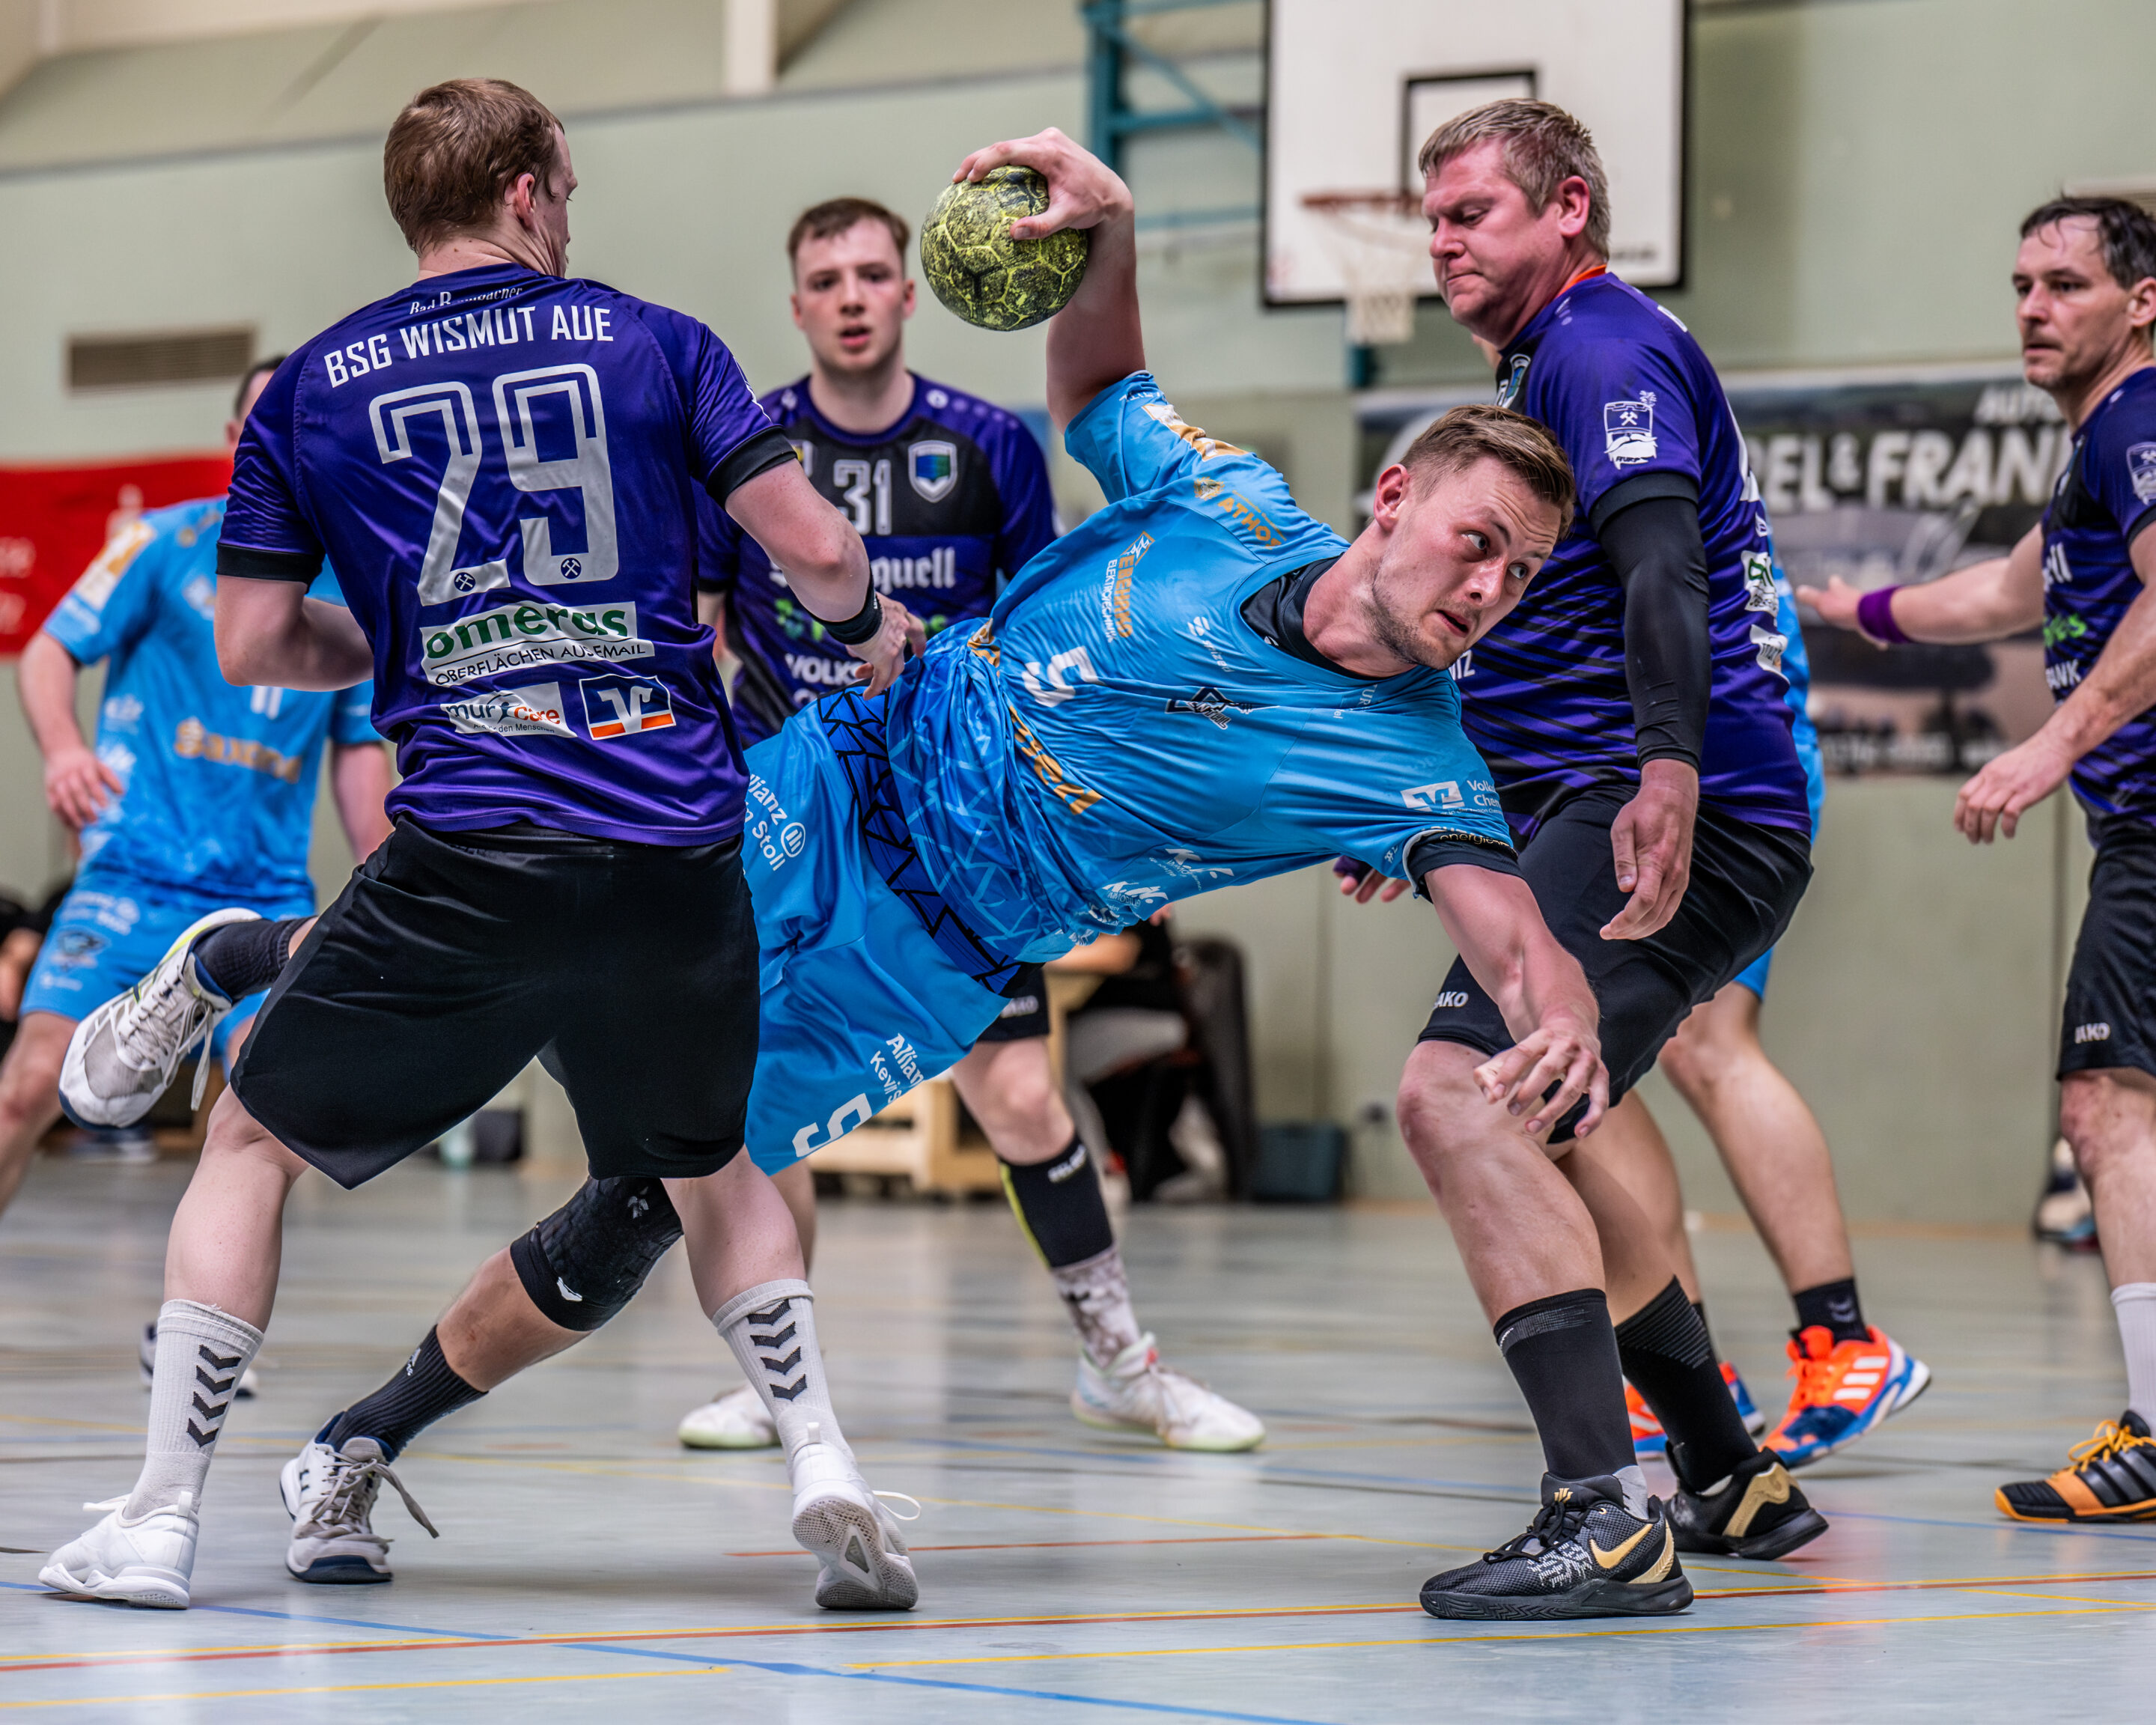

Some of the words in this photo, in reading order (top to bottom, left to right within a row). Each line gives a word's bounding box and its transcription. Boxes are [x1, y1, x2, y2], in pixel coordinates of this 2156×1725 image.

[323, 333, 393, 388] BSG
[399, 305, 536, 360] WISMUT
[550, 305, 614, 342] AUE
[368, 363, 620, 606] 29
[832, 458, 892, 536] 31
[426, 605, 629, 659] omeras
[435, 646, 555, 686] OBERFLÄCHEN
[593, 643, 647, 659] EMAIL
[1021, 645, 1106, 708] 5
[752, 820, 786, 871] Stoll
[886, 1032, 925, 1089] Allian
